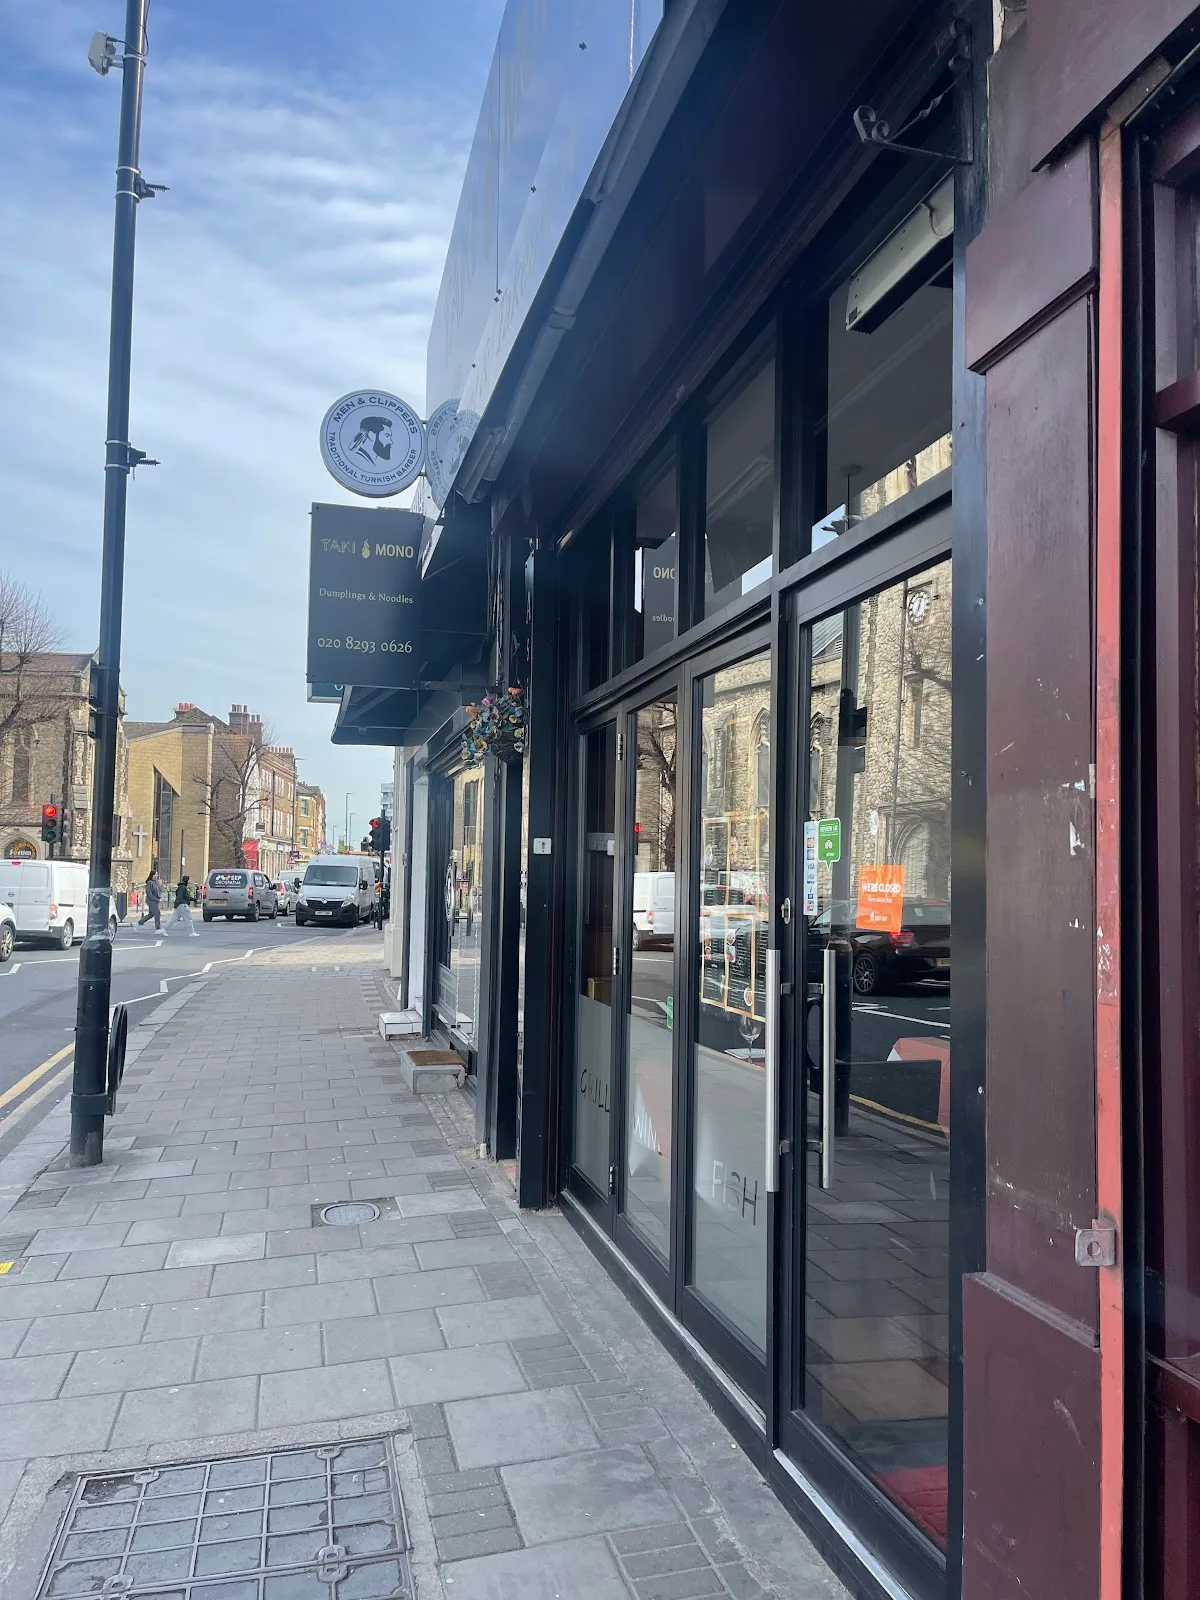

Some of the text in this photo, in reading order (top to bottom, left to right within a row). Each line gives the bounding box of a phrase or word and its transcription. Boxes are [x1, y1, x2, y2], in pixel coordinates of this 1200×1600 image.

[333, 396, 418, 434] MEN & CLIPPERS
[328, 431, 417, 483] TRADITIONAL TURKISH BARBER
[320, 538, 415, 559] YAKI MONO
[319, 587, 414, 604] Dumplings & Noodles
[317, 635, 413, 654] 020 8293 0626
[712, 1159, 758, 1226] FISH
